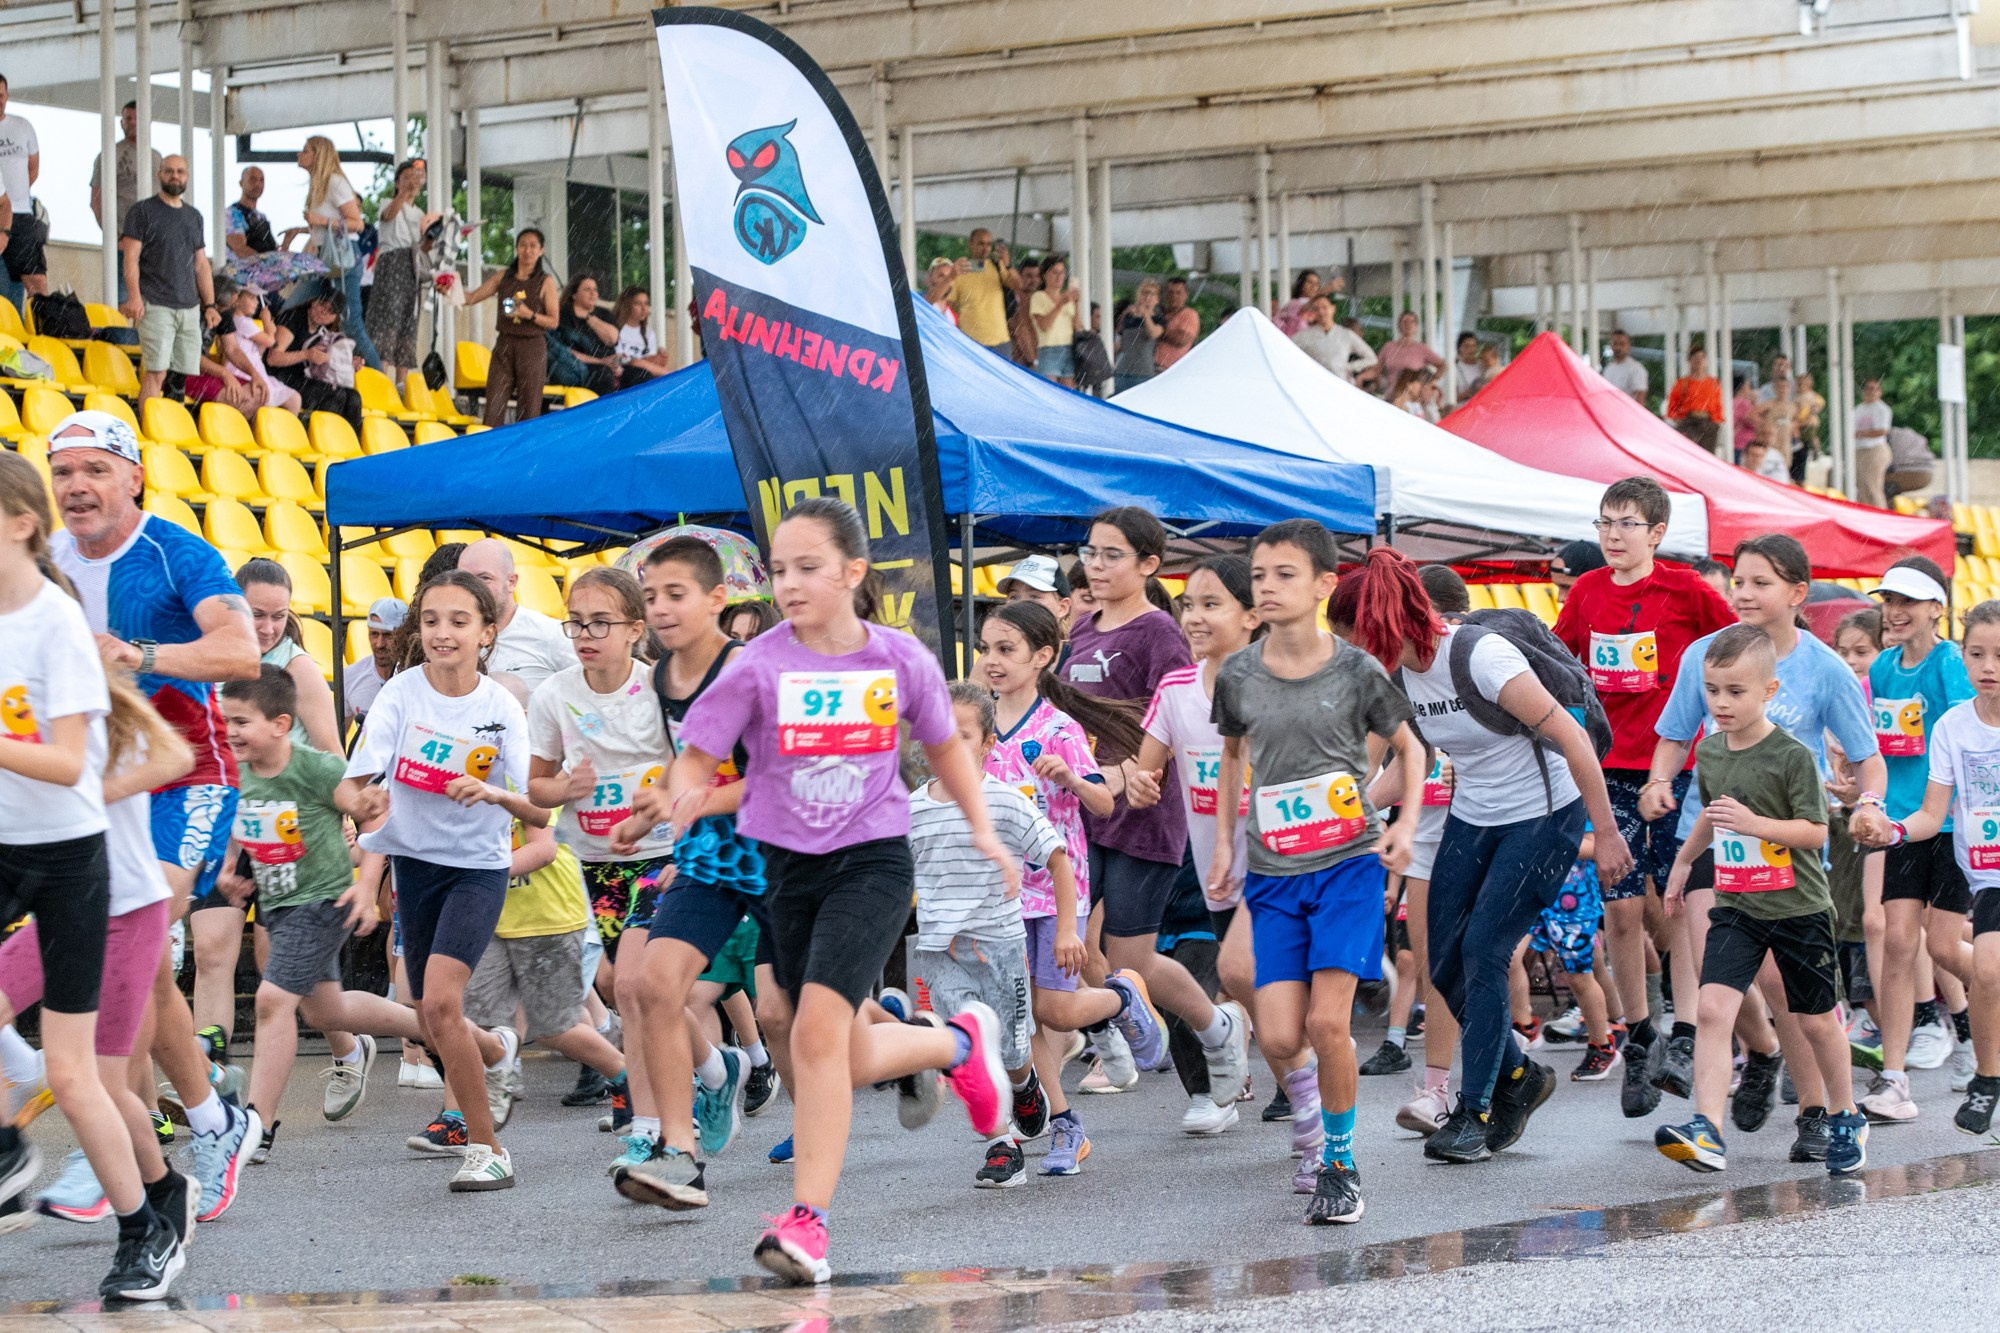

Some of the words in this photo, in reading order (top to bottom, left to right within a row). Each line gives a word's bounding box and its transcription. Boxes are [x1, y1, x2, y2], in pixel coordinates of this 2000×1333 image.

[1596, 645, 1620, 667] 63
[803, 689, 843, 717] 97
[420, 739, 453, 764] 47
[1196, 761, 1219, 783] 74
[593, 783, 623, 806] 73
[1275, 796, 1312, 822] 16
[1722, 840, 1745, 863] 10
[1014, 977, 1027, 1020] ROAD
